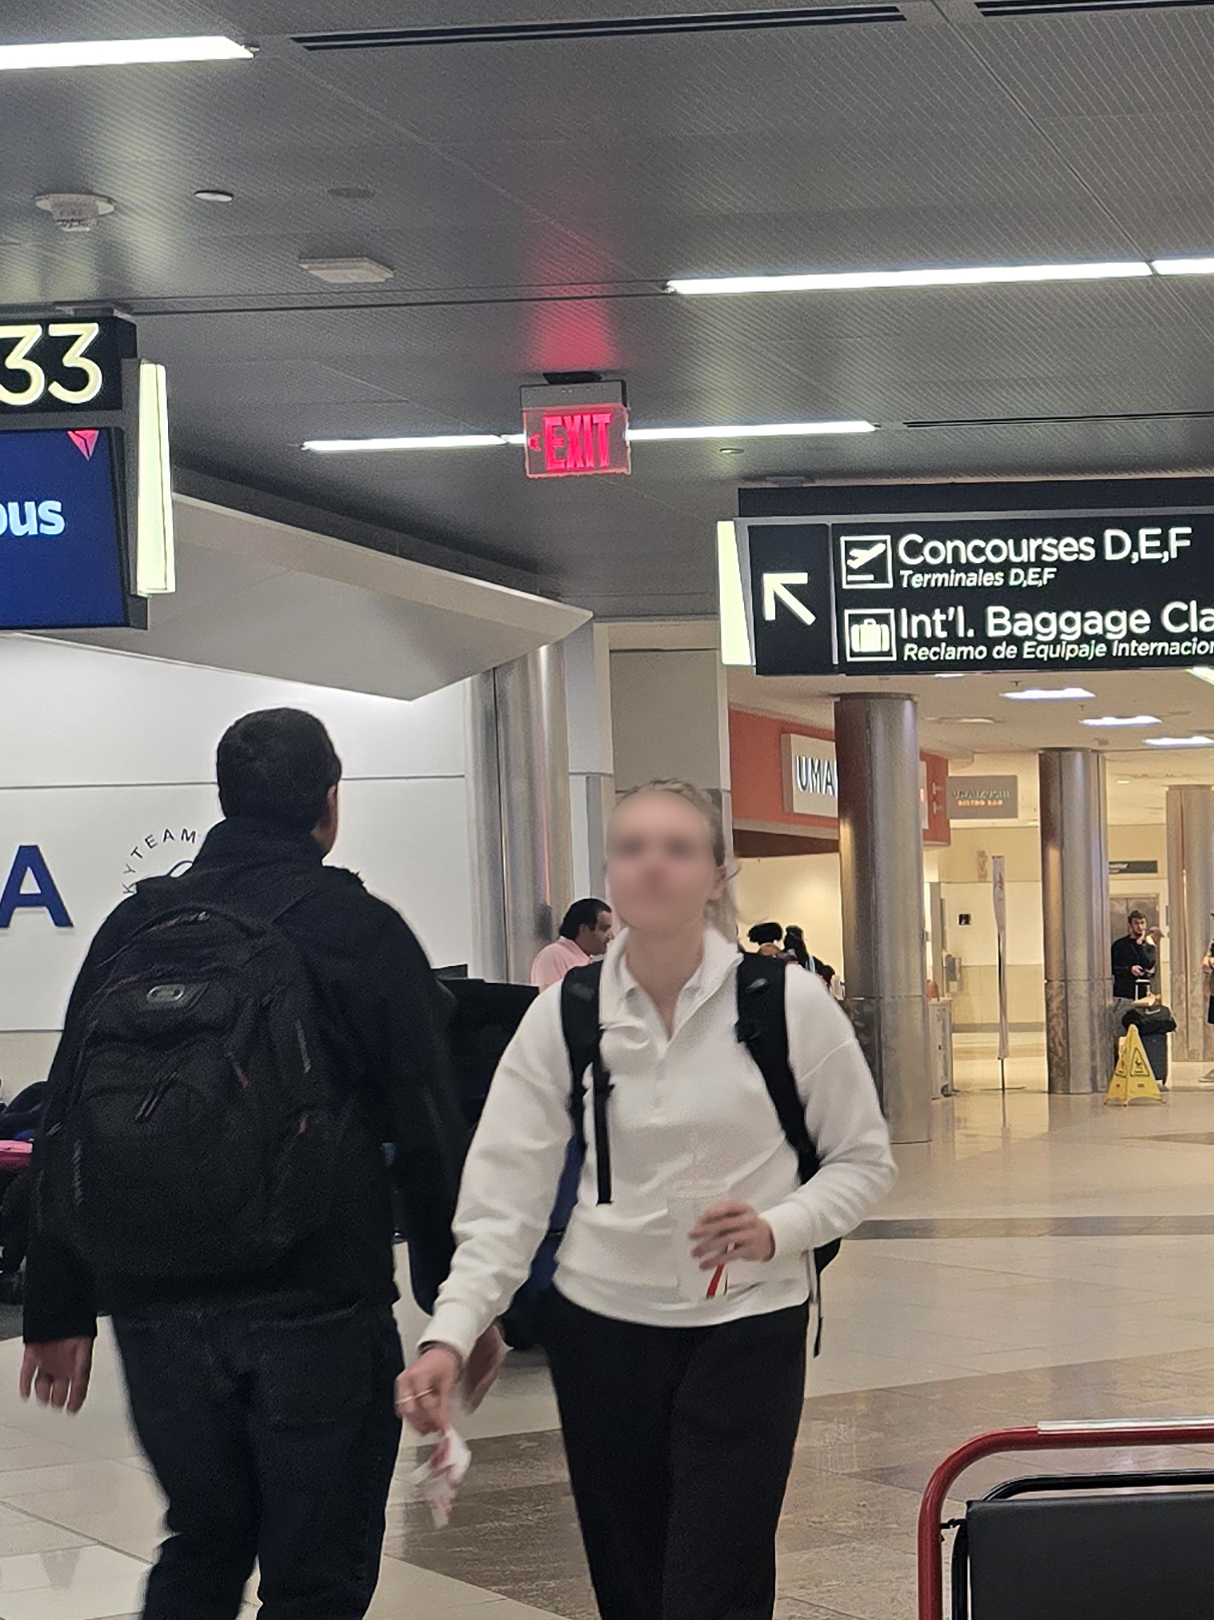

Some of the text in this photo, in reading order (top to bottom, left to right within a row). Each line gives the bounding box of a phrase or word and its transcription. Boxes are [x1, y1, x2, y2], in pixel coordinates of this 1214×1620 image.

[0, 323, 102, 405] 33
[543, 412, 612, 472] EXIT
[0, 500, 66, 537] us
[898, 527, 1193, 566] Concourses D,E,F
[900, 567, 1058, 588] Terminales D,E,F
[901, 605, 975, 640] Int'l.
[987, 606, 1152, 642] Baggage
[904, 641, 988, 661] Reclamo
[992, 641, 1018, 660] de
[1023, 640, 1108, 662] Equipaje
